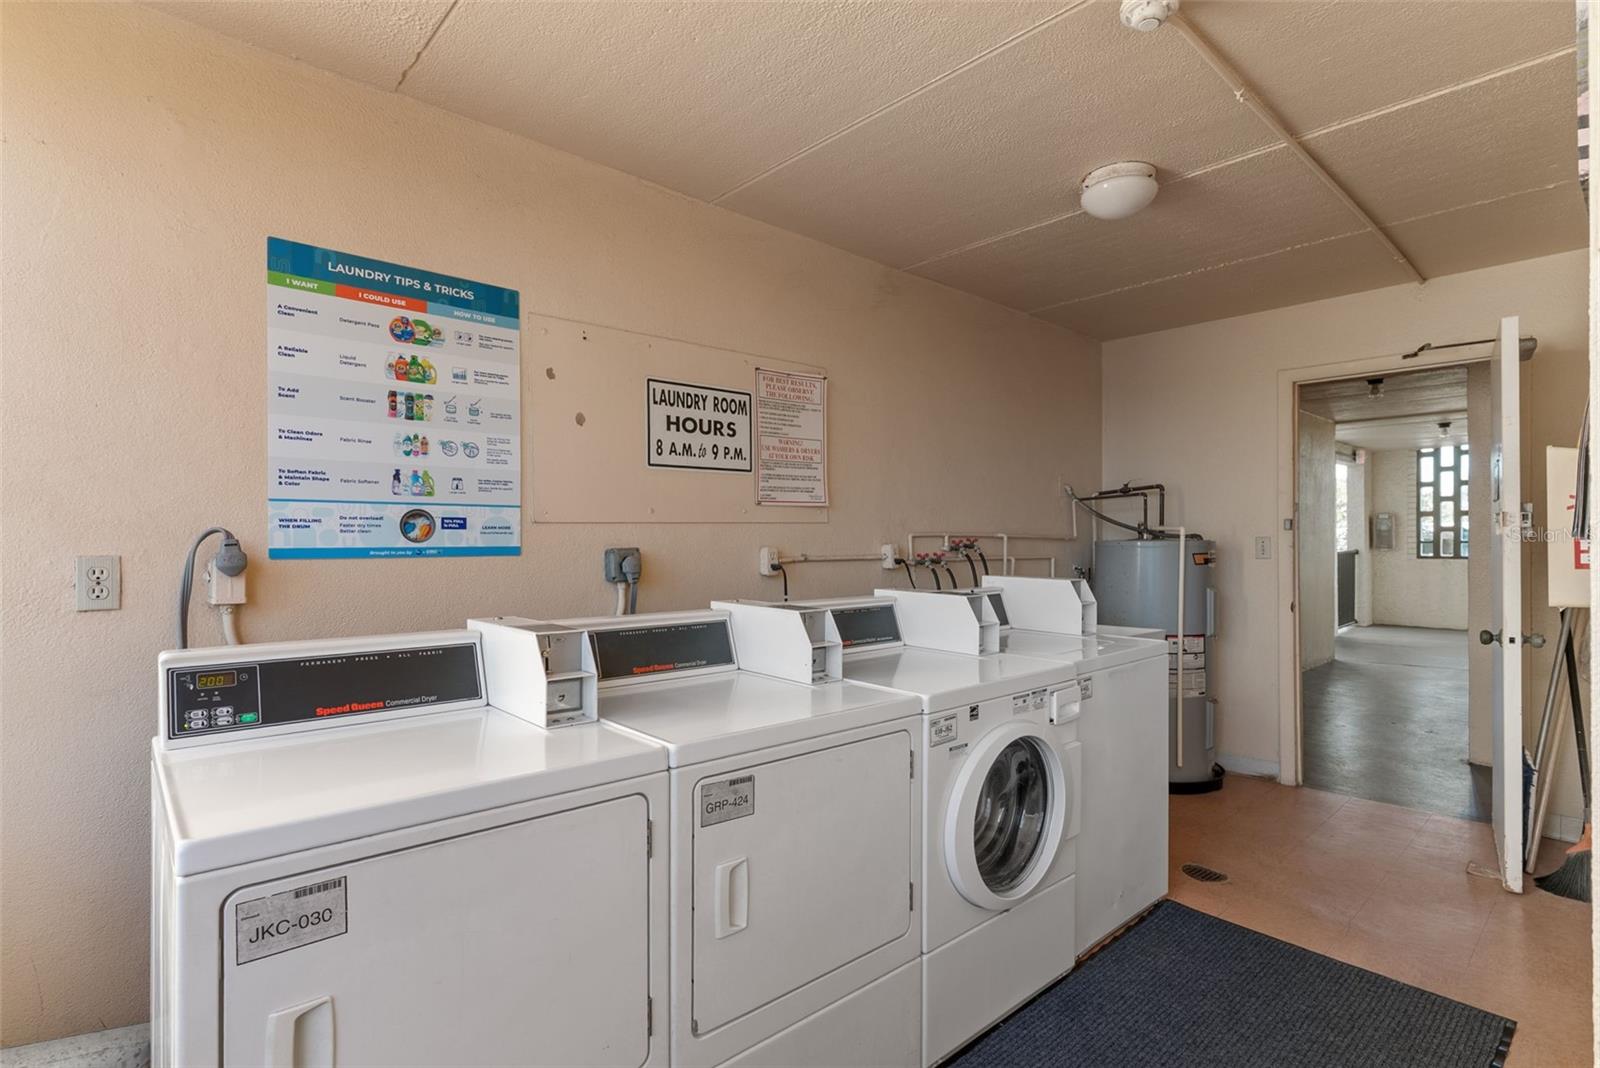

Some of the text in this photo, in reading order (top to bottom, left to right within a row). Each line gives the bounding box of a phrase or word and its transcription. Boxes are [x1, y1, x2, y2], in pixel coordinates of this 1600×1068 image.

[291, 279, 318, 289] WANT
[328, 261, 475, 300] LAUNDRY TIPS & TRICKS
[363, 293, 390, 303] COULD
[392, 298, 407, 306] USE
[283, 305, 318, 315] Convenient
[453, 310, 472, 319] HOW
[482, 315, 496, 323] USE
[339, 317, 367, 327] Detergent
[284, 346, 308, 354] Reliable
[339, 360, 367, 368] Detergent
[776, 377, 790, 385] BEST
[766, 383, 814, 395] PLEASE OBSERVE
[652, 387, 708, 411] LAUNDRY
[713, 396, 748, 416] ROOM
[666, 414, 737, 438] HOURS
[656, 438, 747, 461] 8 A.M. to 9 P.M.
[300, 658, 347, 667] PERMANENT
[632, 665, 653, 675] Speed
[198, 675, 224, 688] 200
[315, 694, 438, 717] Speed Queen Commercial Dryer
[706, 794, 749, 814] GRP-424
[249, 908, 333, 943] JKC-030
